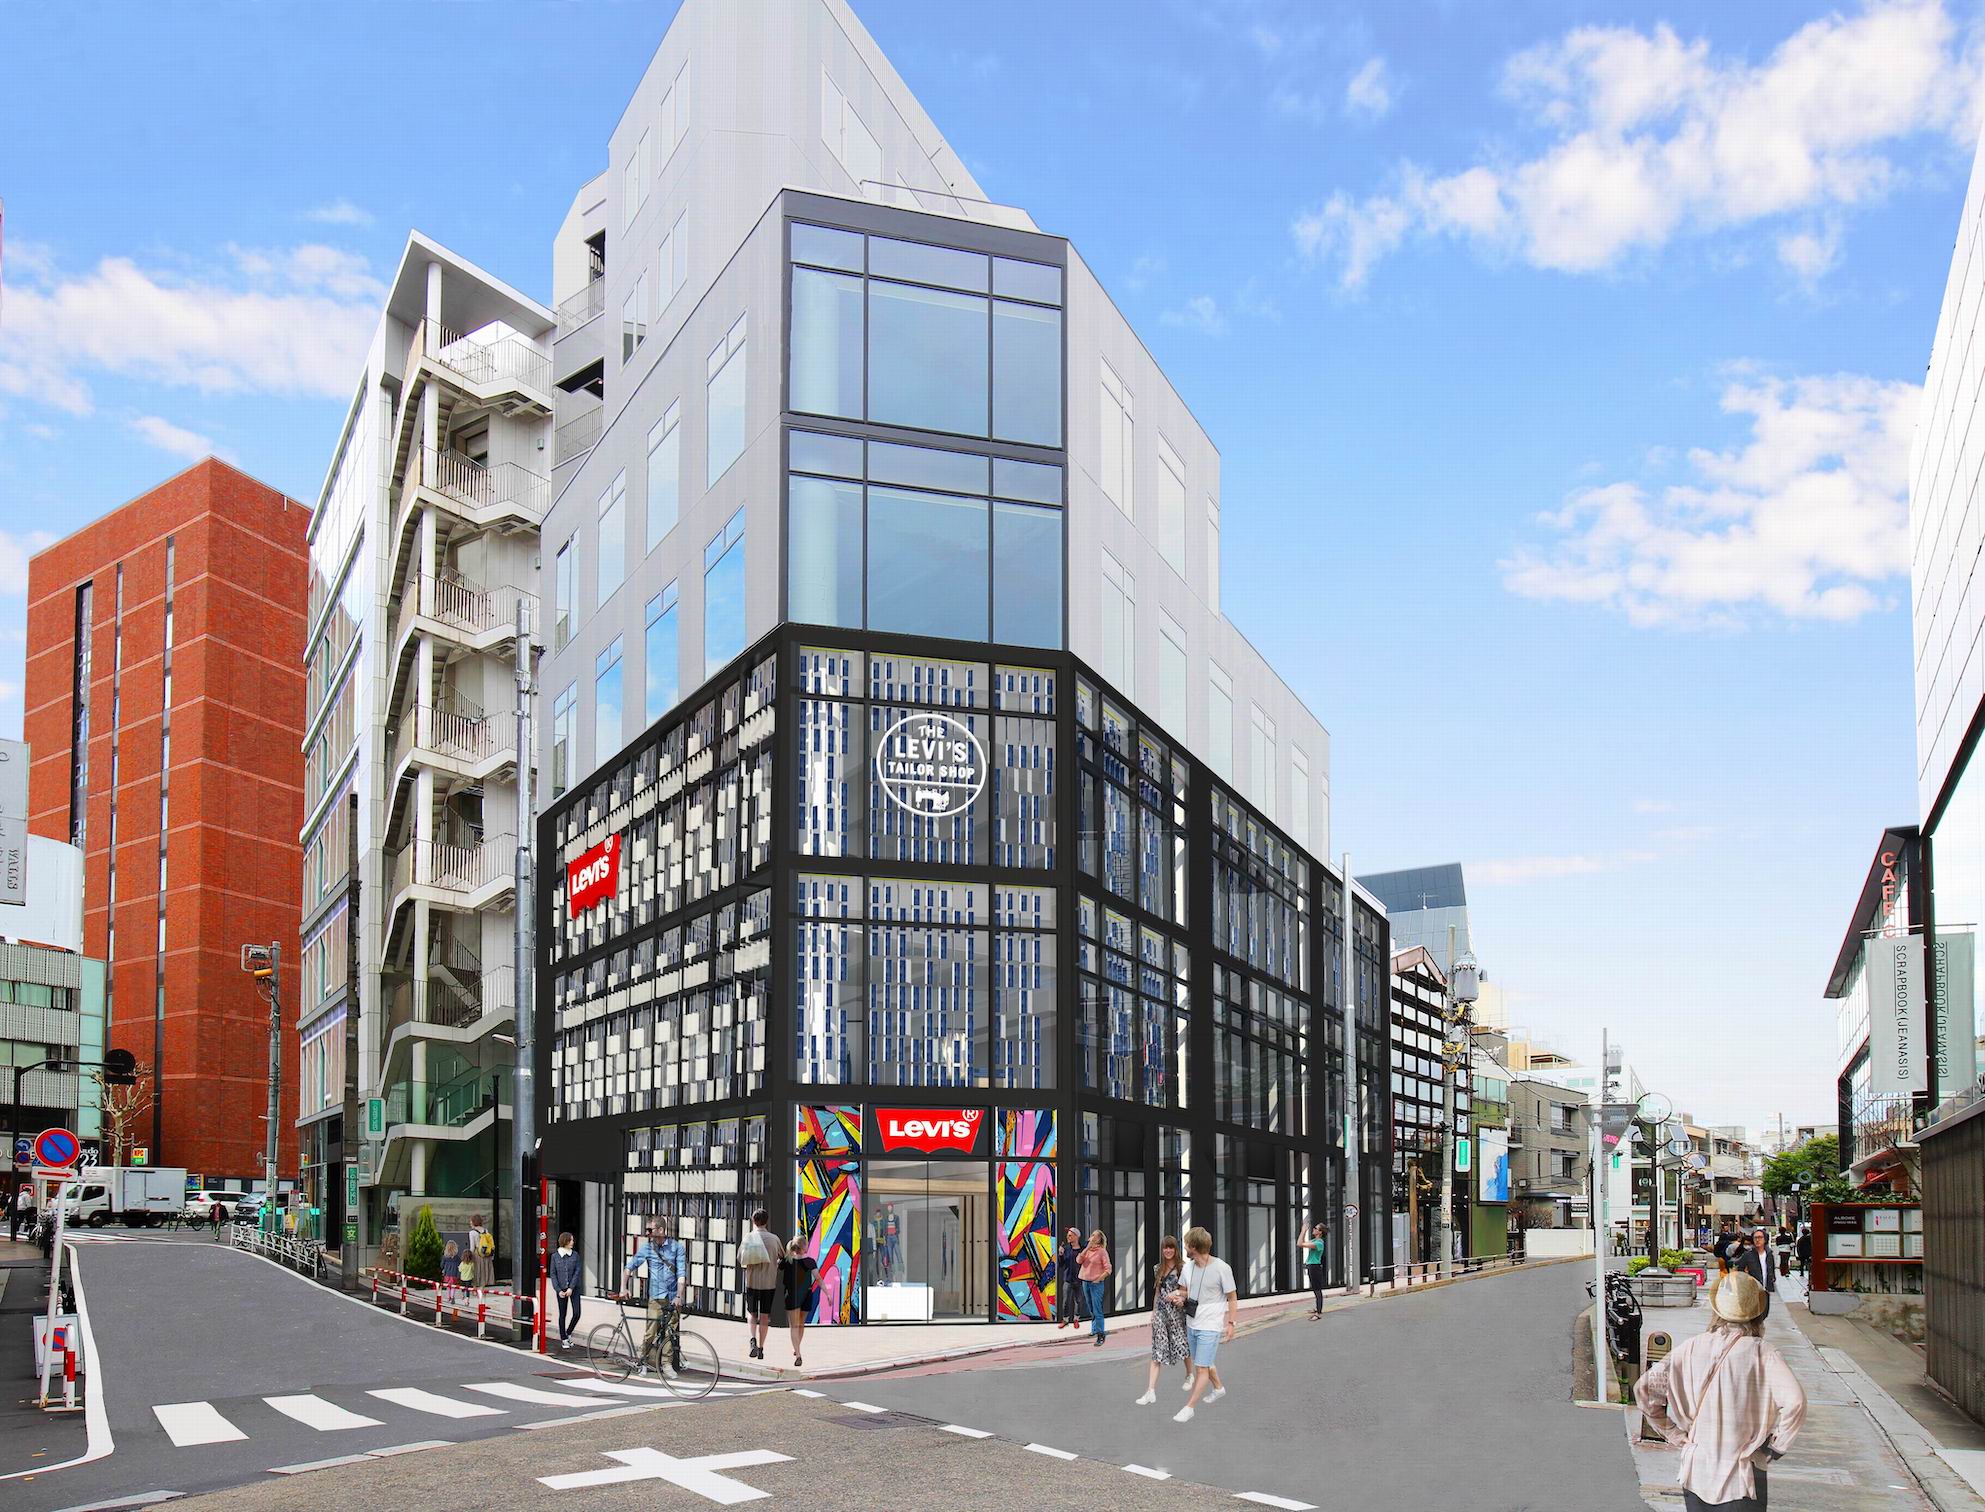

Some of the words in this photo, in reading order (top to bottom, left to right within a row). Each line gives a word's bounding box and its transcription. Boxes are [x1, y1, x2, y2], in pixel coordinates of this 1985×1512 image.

[918, 725, 945, 738] THE
[895, 736, 966, 762] LEVI'S
[888, 761, 934, 777] TAILOR
[939, 764, 975, 779] SHOP
